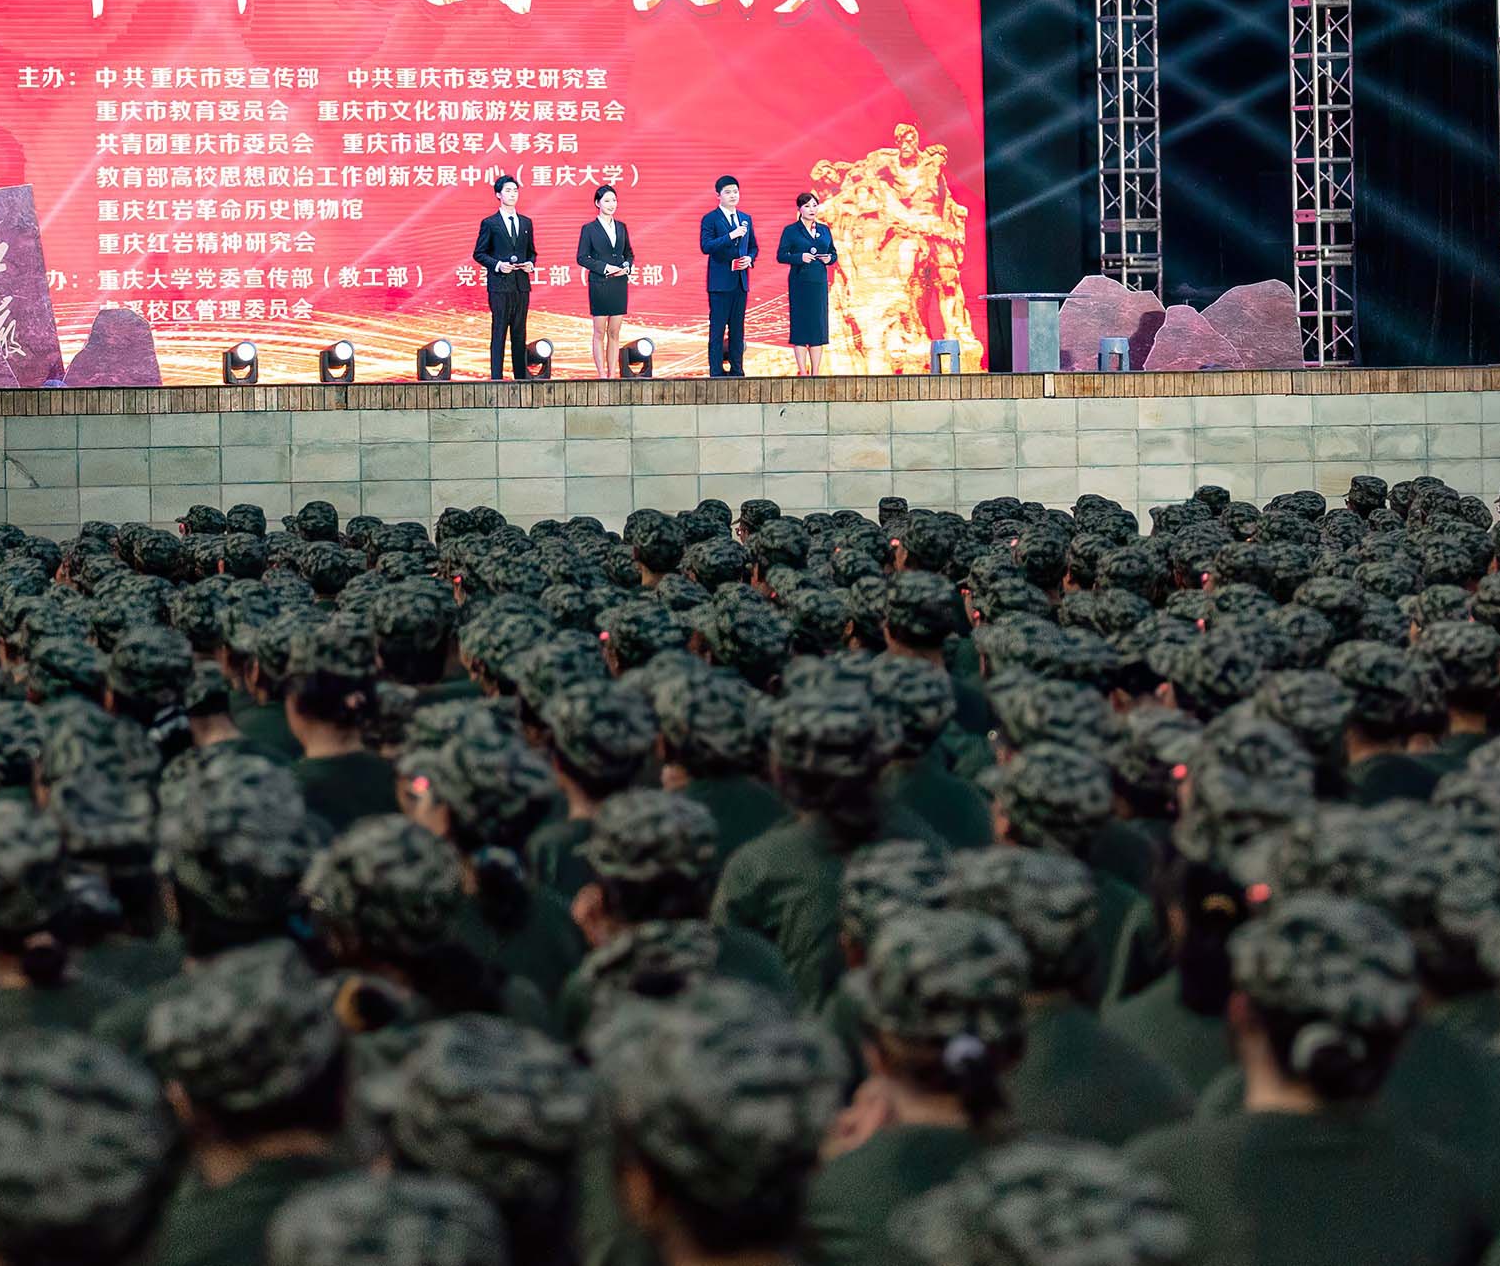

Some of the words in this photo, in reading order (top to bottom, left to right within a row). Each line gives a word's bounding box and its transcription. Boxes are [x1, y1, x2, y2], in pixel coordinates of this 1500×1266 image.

[18, 66, 76, 88] 主办：
[95, 66, 319, 89] 中共重庆市委宣传部
[347, 67, 608, 89] 中共重庆市委党史研究室
[95, 100, 289, 122] 重庆市教育委员会
[317, 100, 625, 122] 重庆市文化和旅游发展委员会
[96, 133, 314, 155] 共青团重庆市委员会
[342, 133, 578, 154] 重庆市退役军人事务局
[98, 198, 363, 221] 重庆红岩革命历史博物馆
[98, 232, 316, 254] 重庆红岩精神研究会
[97, 267, 424, 290] 重庆大学党委宣传部（教工部）
